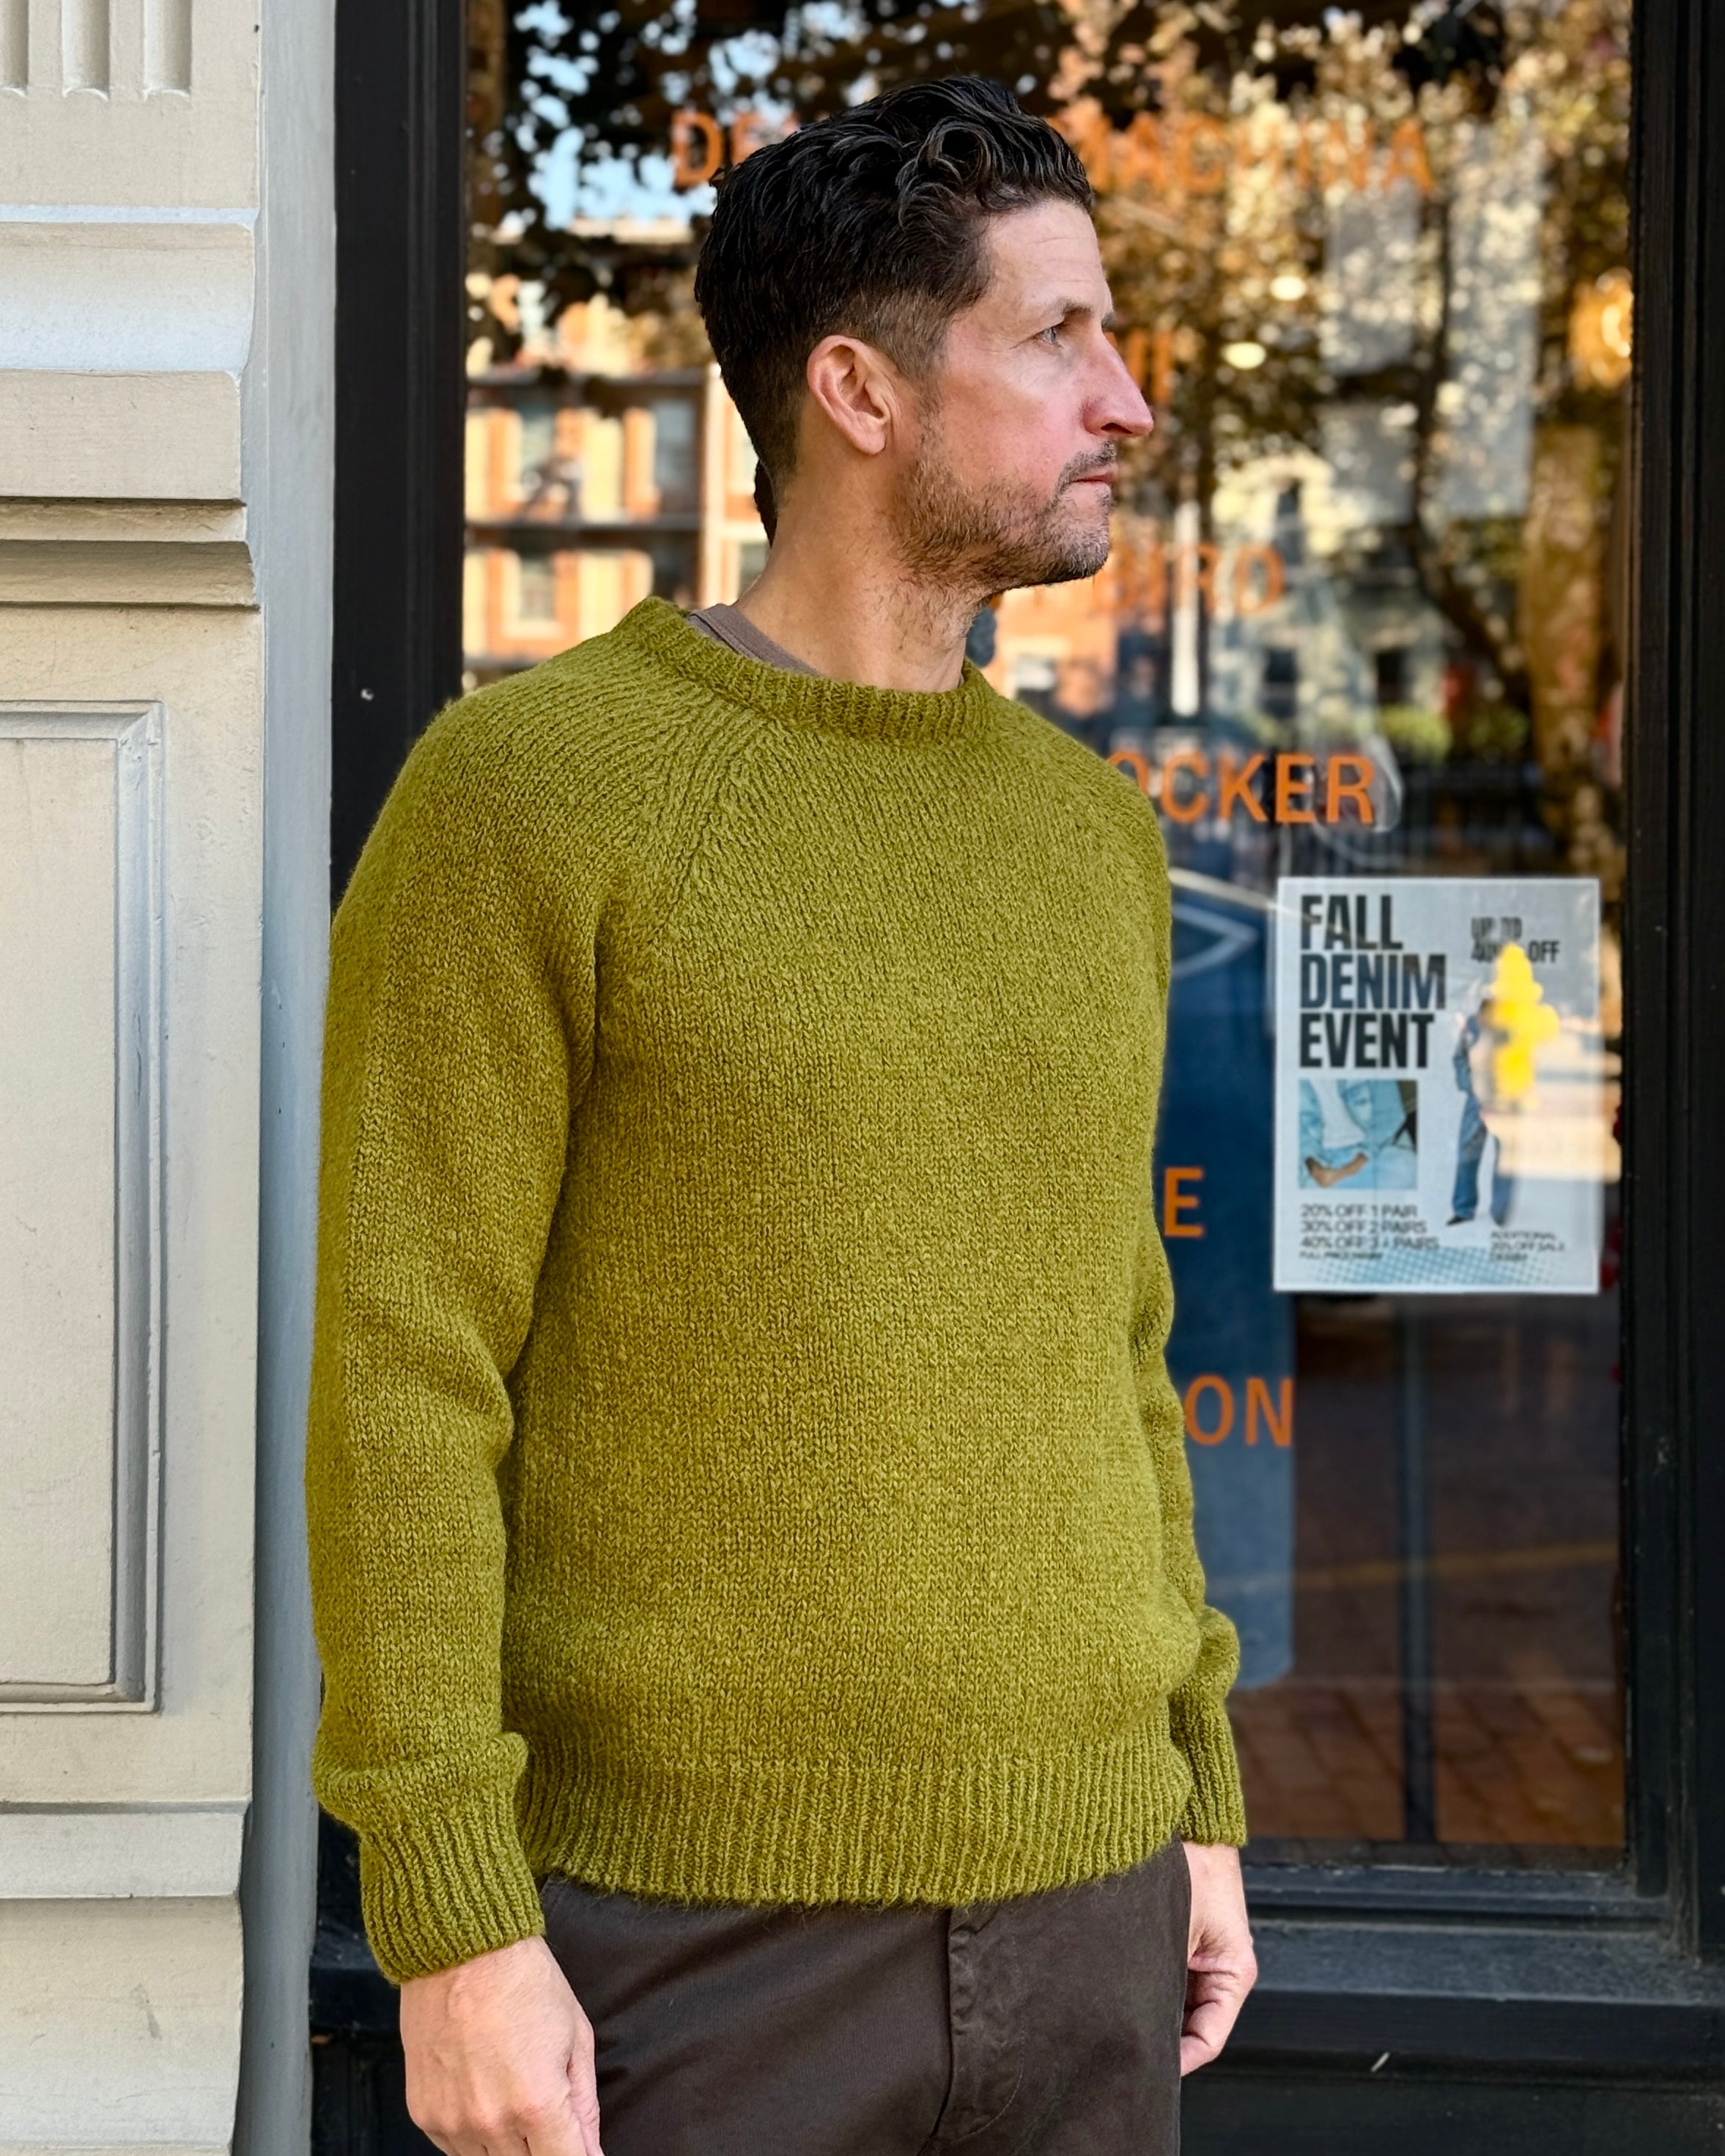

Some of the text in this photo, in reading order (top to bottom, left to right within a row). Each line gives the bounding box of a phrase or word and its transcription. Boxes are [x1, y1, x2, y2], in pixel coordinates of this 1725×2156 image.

[1301, 894, 1403, 950] FALL
[1471, 917, 1523, 940] UP TO
[1528, 939, 1561, 963] OFF
[1300, 953, 1447, 1010] DENIM
[1299, 1013, 1435, 1068] EVENT
[1301, 1203, 1332, 1217] 20%
[1334, 1203, 1367, 1217] OFF
[1381, 1203, 1419, 1218] PAIR
[1300, 1219, 1427, 1234] 30% OFF 2 PAIRS
[1301, 1236, 1332, 1249] 40%
[1334, 1236, 1367, 1249] OFF
[1394, 1236, 1440, 1250] PAIRS
